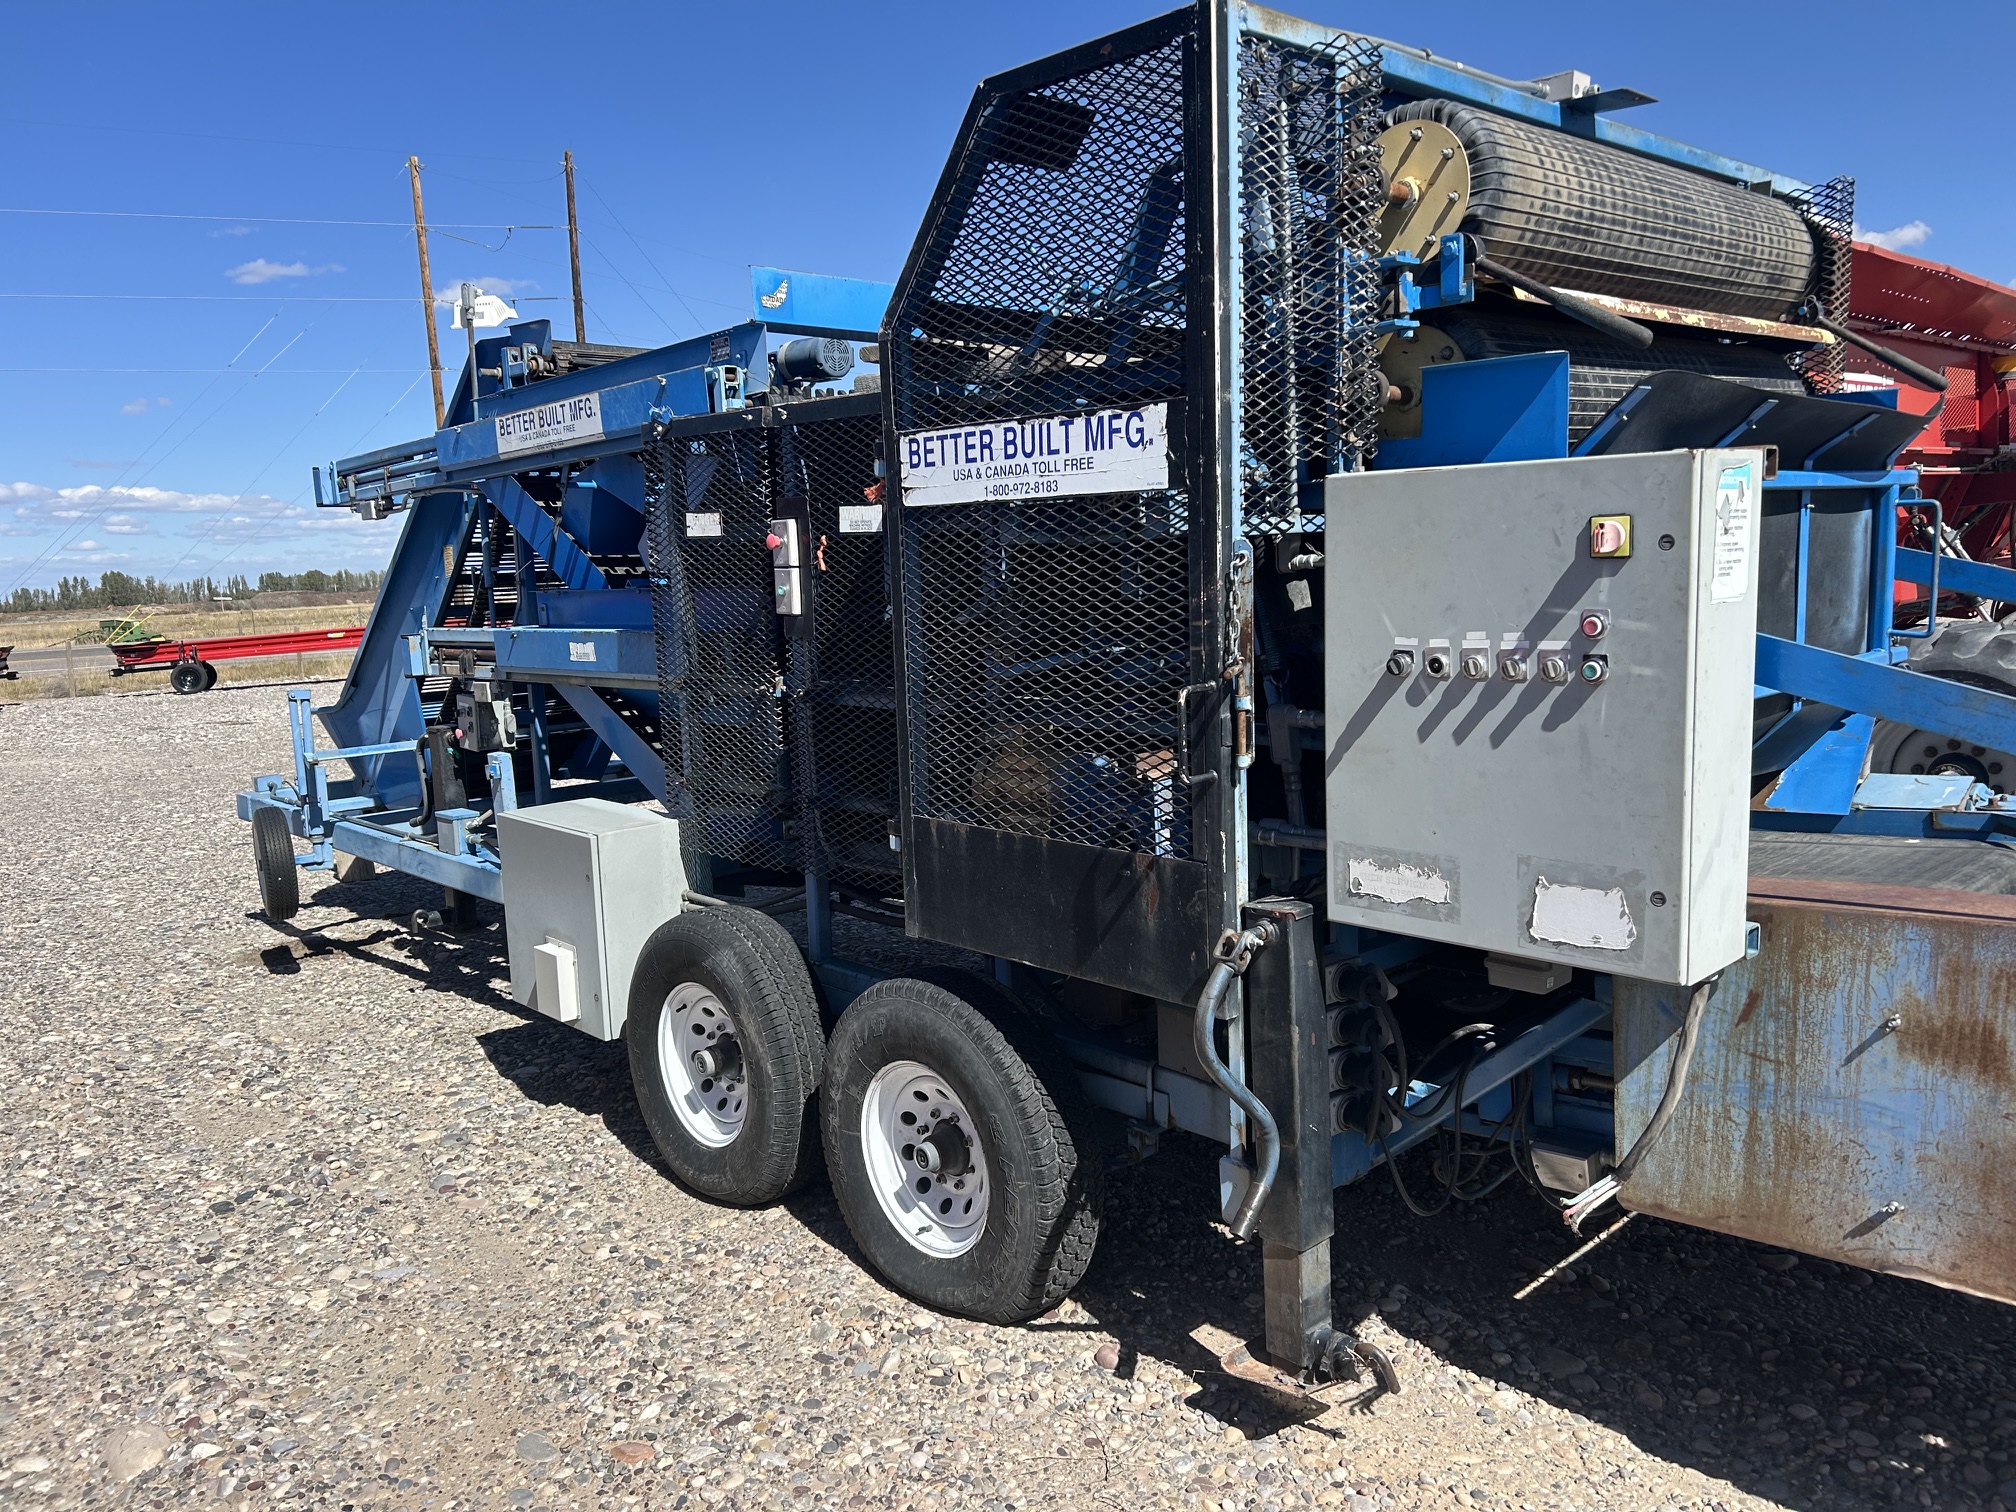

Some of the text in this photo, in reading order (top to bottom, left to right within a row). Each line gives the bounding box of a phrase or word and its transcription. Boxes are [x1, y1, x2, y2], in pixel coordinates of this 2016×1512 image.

[500, 397, 596, 436] BETTER BUILT MFG.
[532, 429, 551, 440] CANADA
[551, 426, 562, 436] TOLL
[563, 423, 576, 434] FREE
[908, 429, 994, 470] BETTER
[1003, 419, 1075, 460] BUILT
[952, 456, 1094, 482] USA & CANADA TOLL FREE
[984, 480, 1059, 498] 1-800-972-8183
[840, 507, 881, 520] WARNING
[1385, 876, 1437, 891] SERVICING
